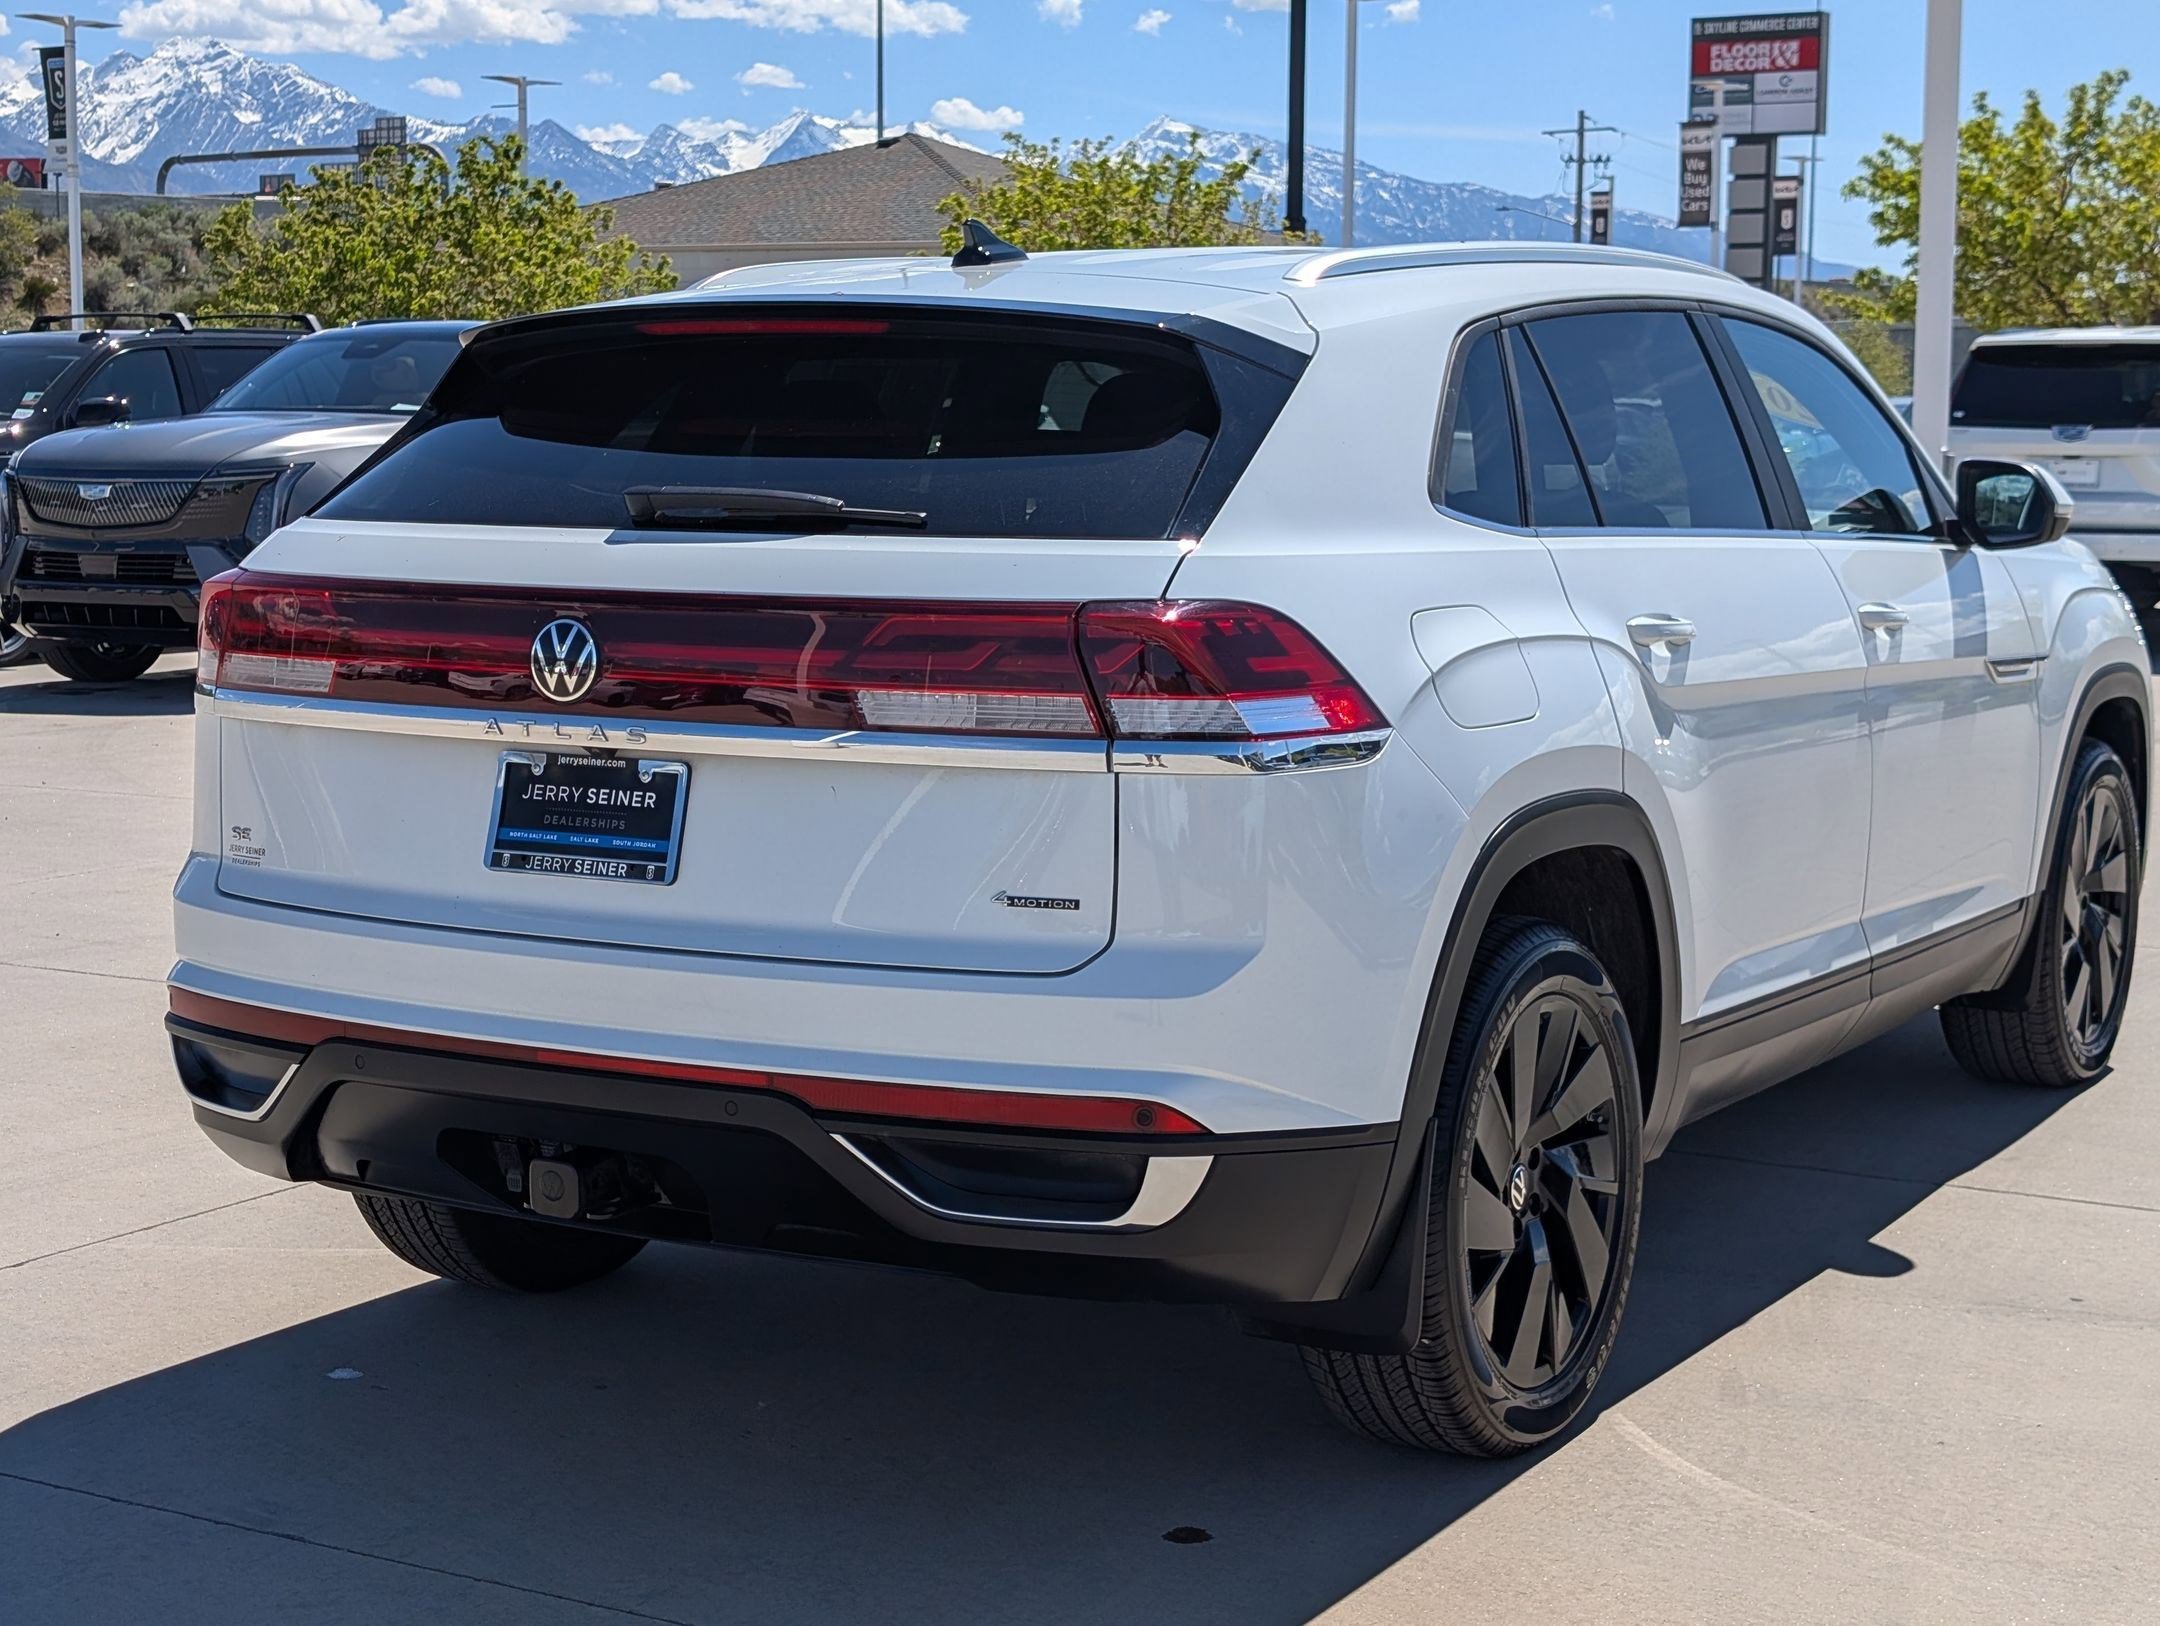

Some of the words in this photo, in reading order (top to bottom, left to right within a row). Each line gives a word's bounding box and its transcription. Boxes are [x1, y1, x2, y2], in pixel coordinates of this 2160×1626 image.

[1704, 21, 1739, 35] SKYLINE
[1739, 18, 1786, 32] COMMERCE
[1786, 15, 1819, 29] CENTER
[1710, 42, 1770, 59] FLOOR
[1710, 57, 1770, 73] DECOR
[1685, 158, 1707, 171] We
[1684, 172, 1708, 187] Buy
[1682, 200, 1708, 211] Cars
[483, 716, 647, 744] ATLAS
[557, 755, 626, 768] jerryseiner.com
[522, 783, 584, 803] JERRY
[586, 788, 657, 809] SEINER
[543, 814, 626, 830] DEALERSHIPS
[509, 831, 528, 839] NORTH
[570, 835, 583, 843] SALT
[613, 839, 632, 847] SOUTH
[633, 841, 657, 849] JORDAN
[229, 843, 245, 854] JERRY
[245, 846, 266, 857] SEINER
[525, 855, 572, 872] JERRY
[573, 859, 628, 877] SEINER
[991, 890, 1076, 909] 4MOTION
